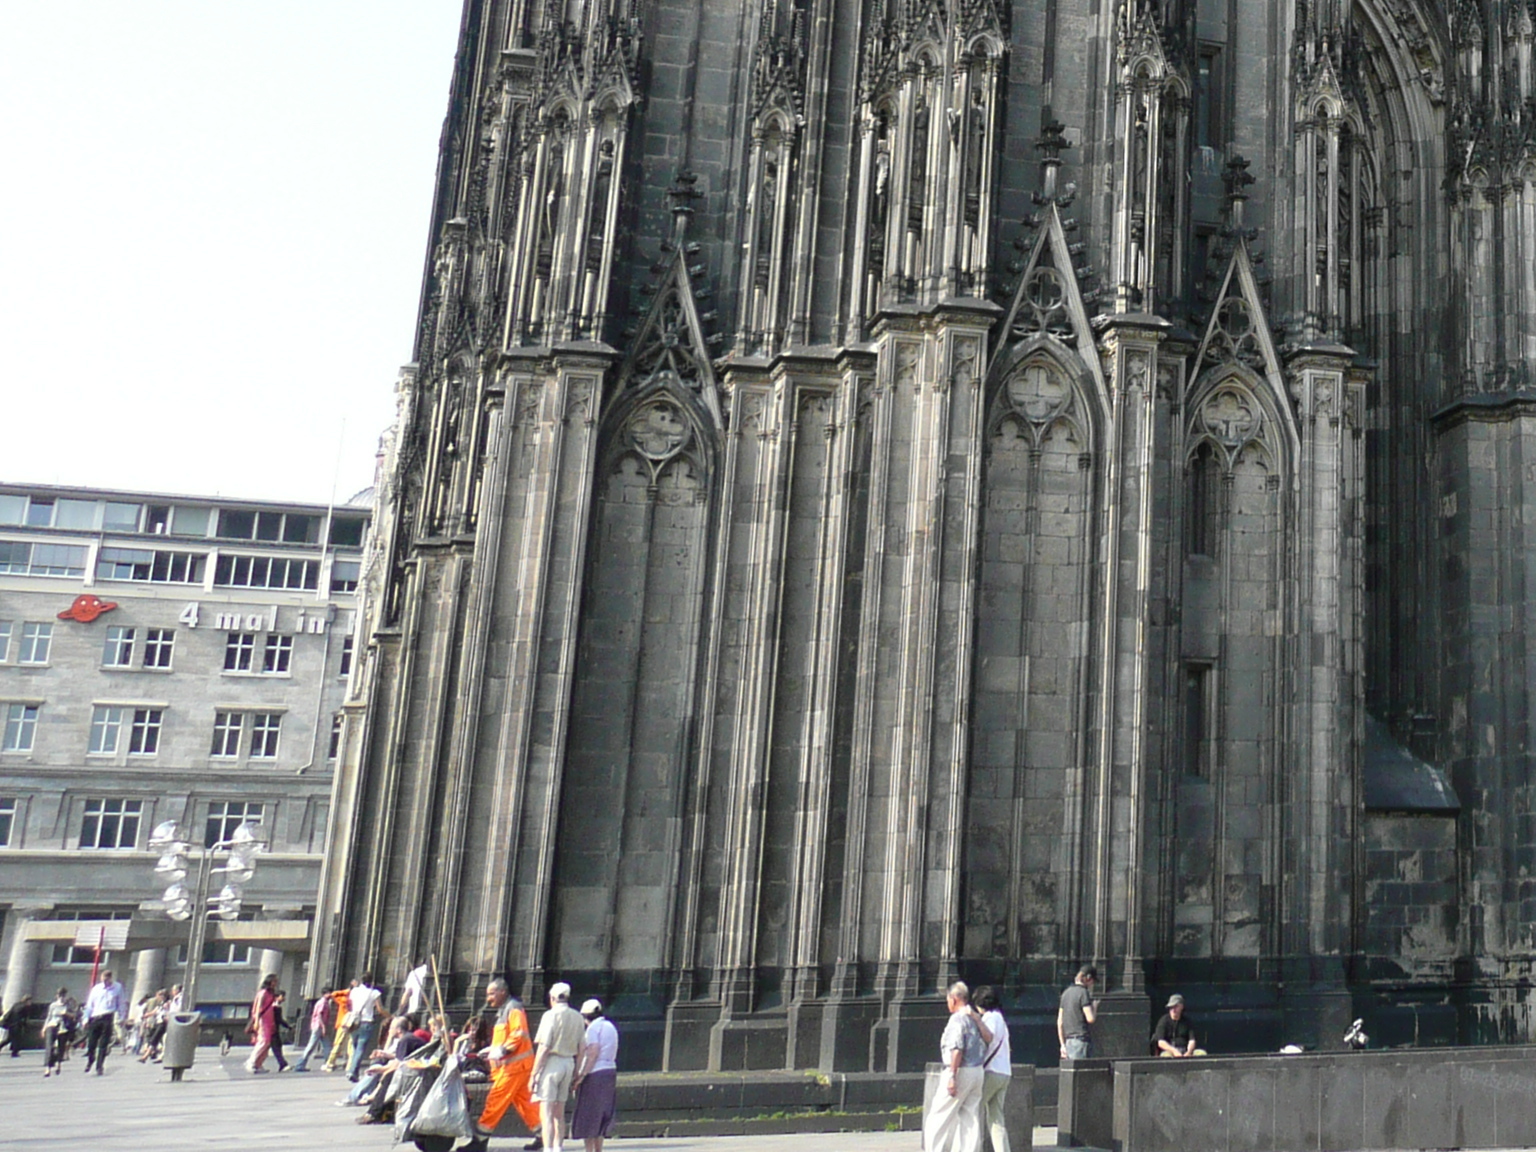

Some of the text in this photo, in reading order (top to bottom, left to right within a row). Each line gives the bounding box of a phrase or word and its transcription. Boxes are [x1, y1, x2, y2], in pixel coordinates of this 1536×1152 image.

[179, 602, 199, 628] 4
[215, 605, 278, 632] mal
[296, 608, 325, 634] in
